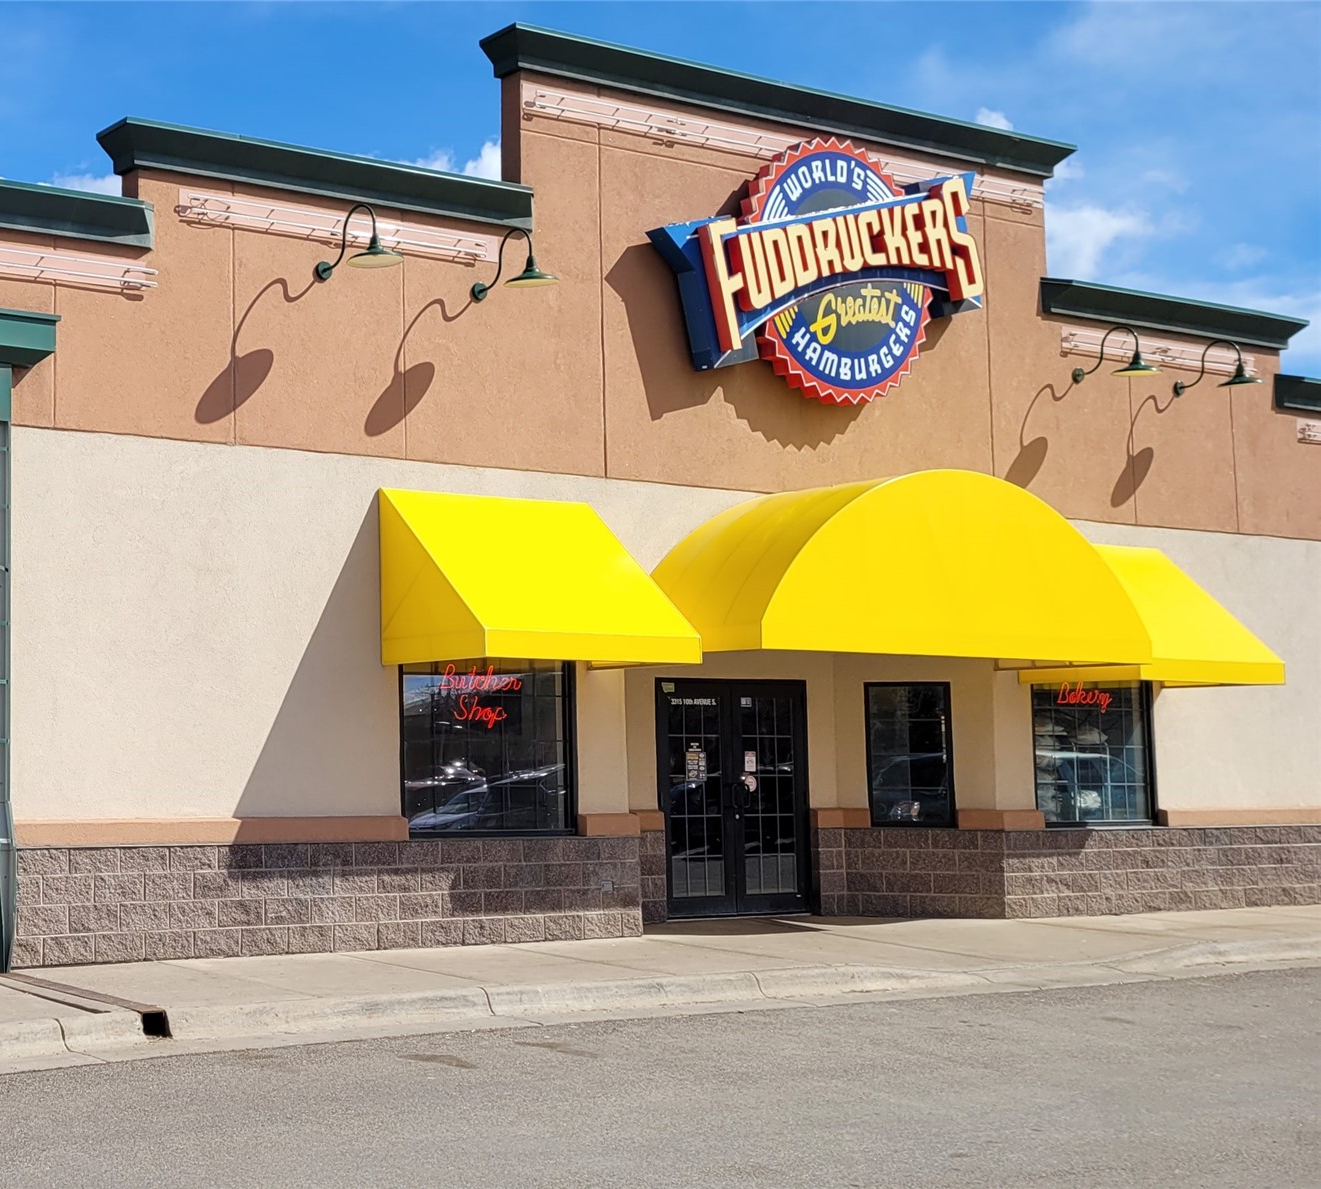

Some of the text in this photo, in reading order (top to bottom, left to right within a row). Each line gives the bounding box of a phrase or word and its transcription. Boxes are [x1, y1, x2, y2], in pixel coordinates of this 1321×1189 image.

[784, 160, 866, 202] WORLD'S
[709, 178, 984, 350] FUDDRUCKERS
[810, 283, 901, 345] Greatest
[792, 304, 916, 380] HAMBURGERS
[440, 663, 522, 691] Butcher
[1057, 680, 1112, 713] Bakery
[450, 694, 507, 729] Shop
